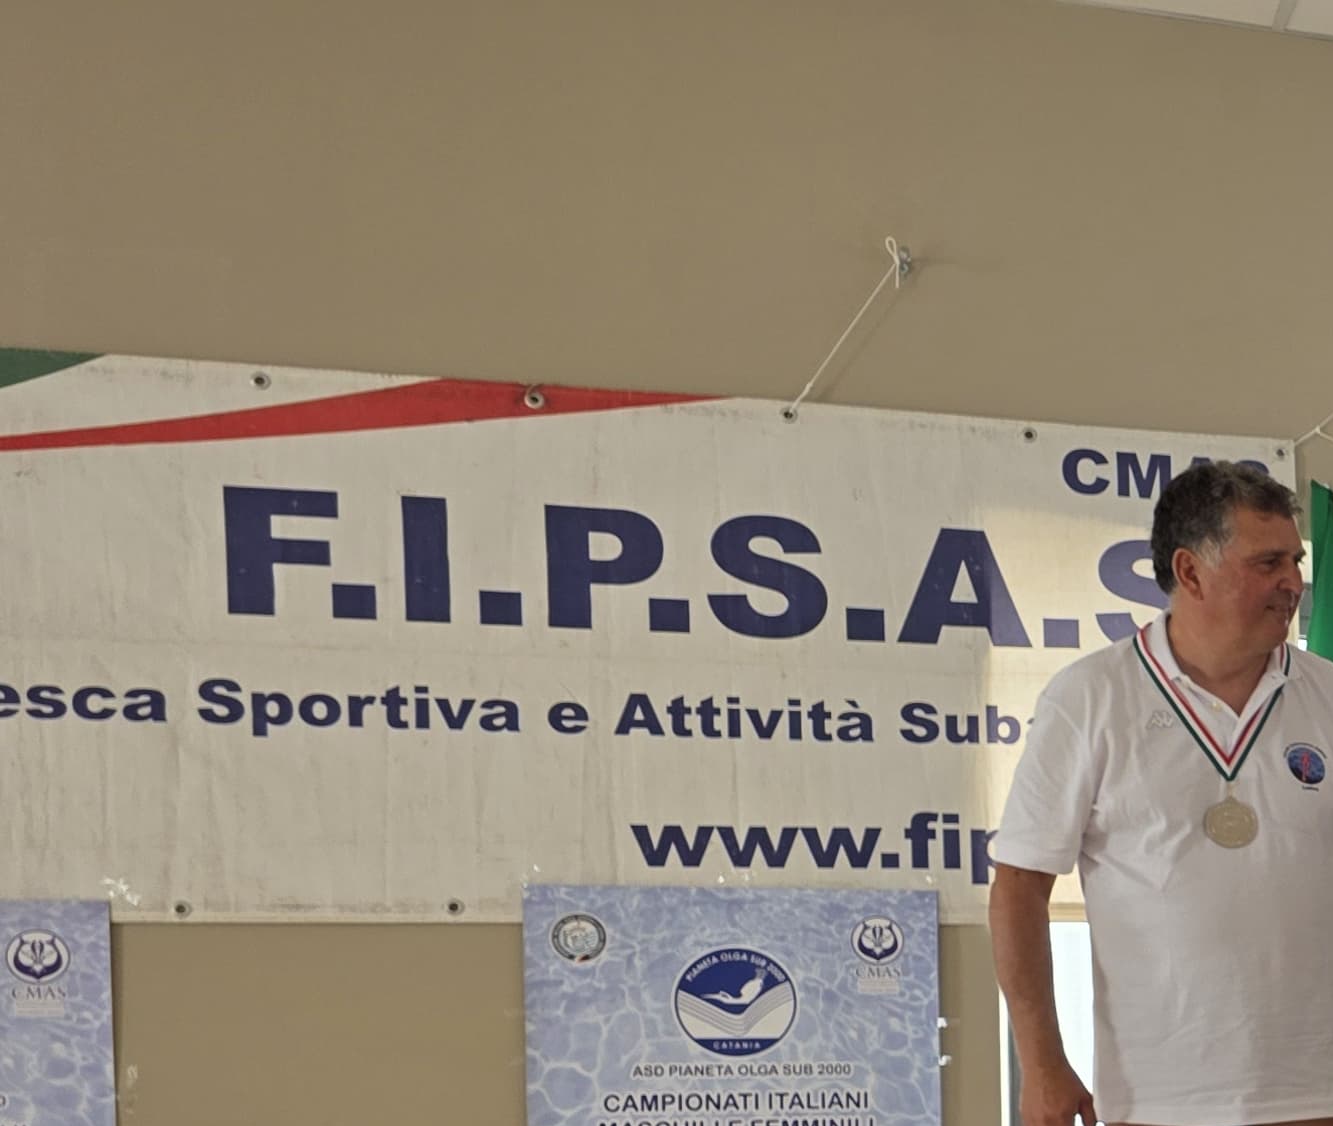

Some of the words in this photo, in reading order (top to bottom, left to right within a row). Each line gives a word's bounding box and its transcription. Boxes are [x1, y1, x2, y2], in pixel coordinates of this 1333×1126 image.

[0, 684, 166, 722] esca
[198, 679, 520, 738] Sportiva
[547, 701, 588, 734] e
[615, 693, 874, 743] Attività
[631, 813, 998, 885] www.fip
[855, 966, 901, 978] CMAS
[12, 986, 67, 999] CMAS
[713, 1041, 761, 1050] CATANIA
[633, 1064, 665, 1078] ASD
[669, 1063, 734, 1078] PIANETA
[738, 1063, 779, 1077] OLGA
[783, 1063, 812, 1076] SUB
[818, 1063, 851, 1075] 2000
[604, 1094, 759, 1112] CAMPIONATI
[768, 1092, 869, 1110] ITALIANI
